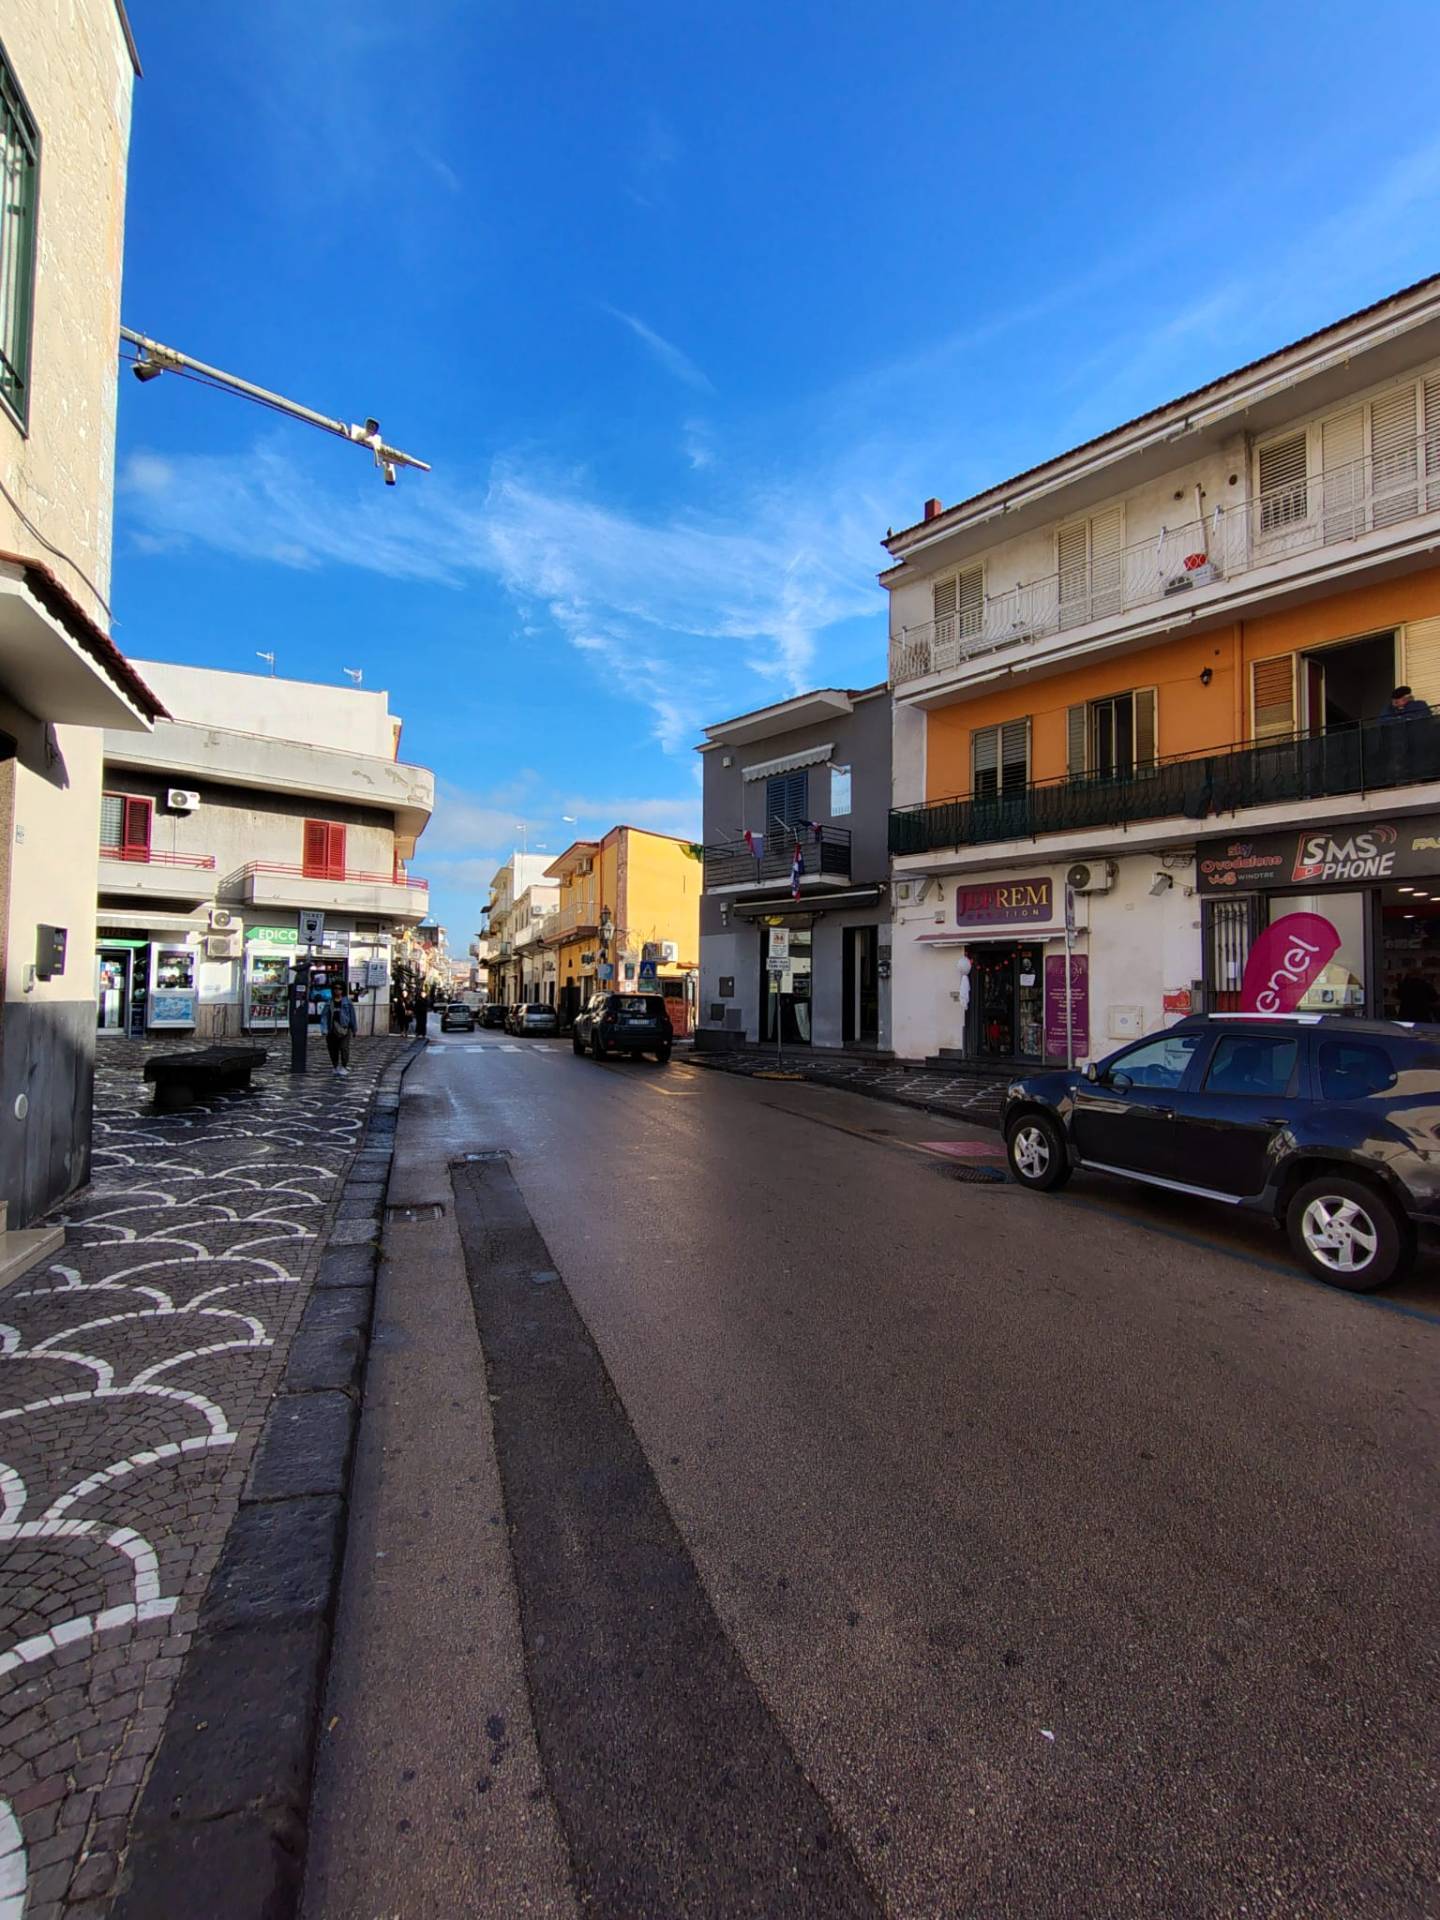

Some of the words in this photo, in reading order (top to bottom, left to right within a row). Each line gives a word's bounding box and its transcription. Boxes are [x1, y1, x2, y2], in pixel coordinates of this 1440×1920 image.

[1215, 855, 1282, 870] vodafone
[1303, 834, 1378, 865] SMS
[1237, 871, 1274, 881] WINDTRE
[1321, 851, 1396, 880] PHONE
[1256, 935, 1320, 1013] enel
